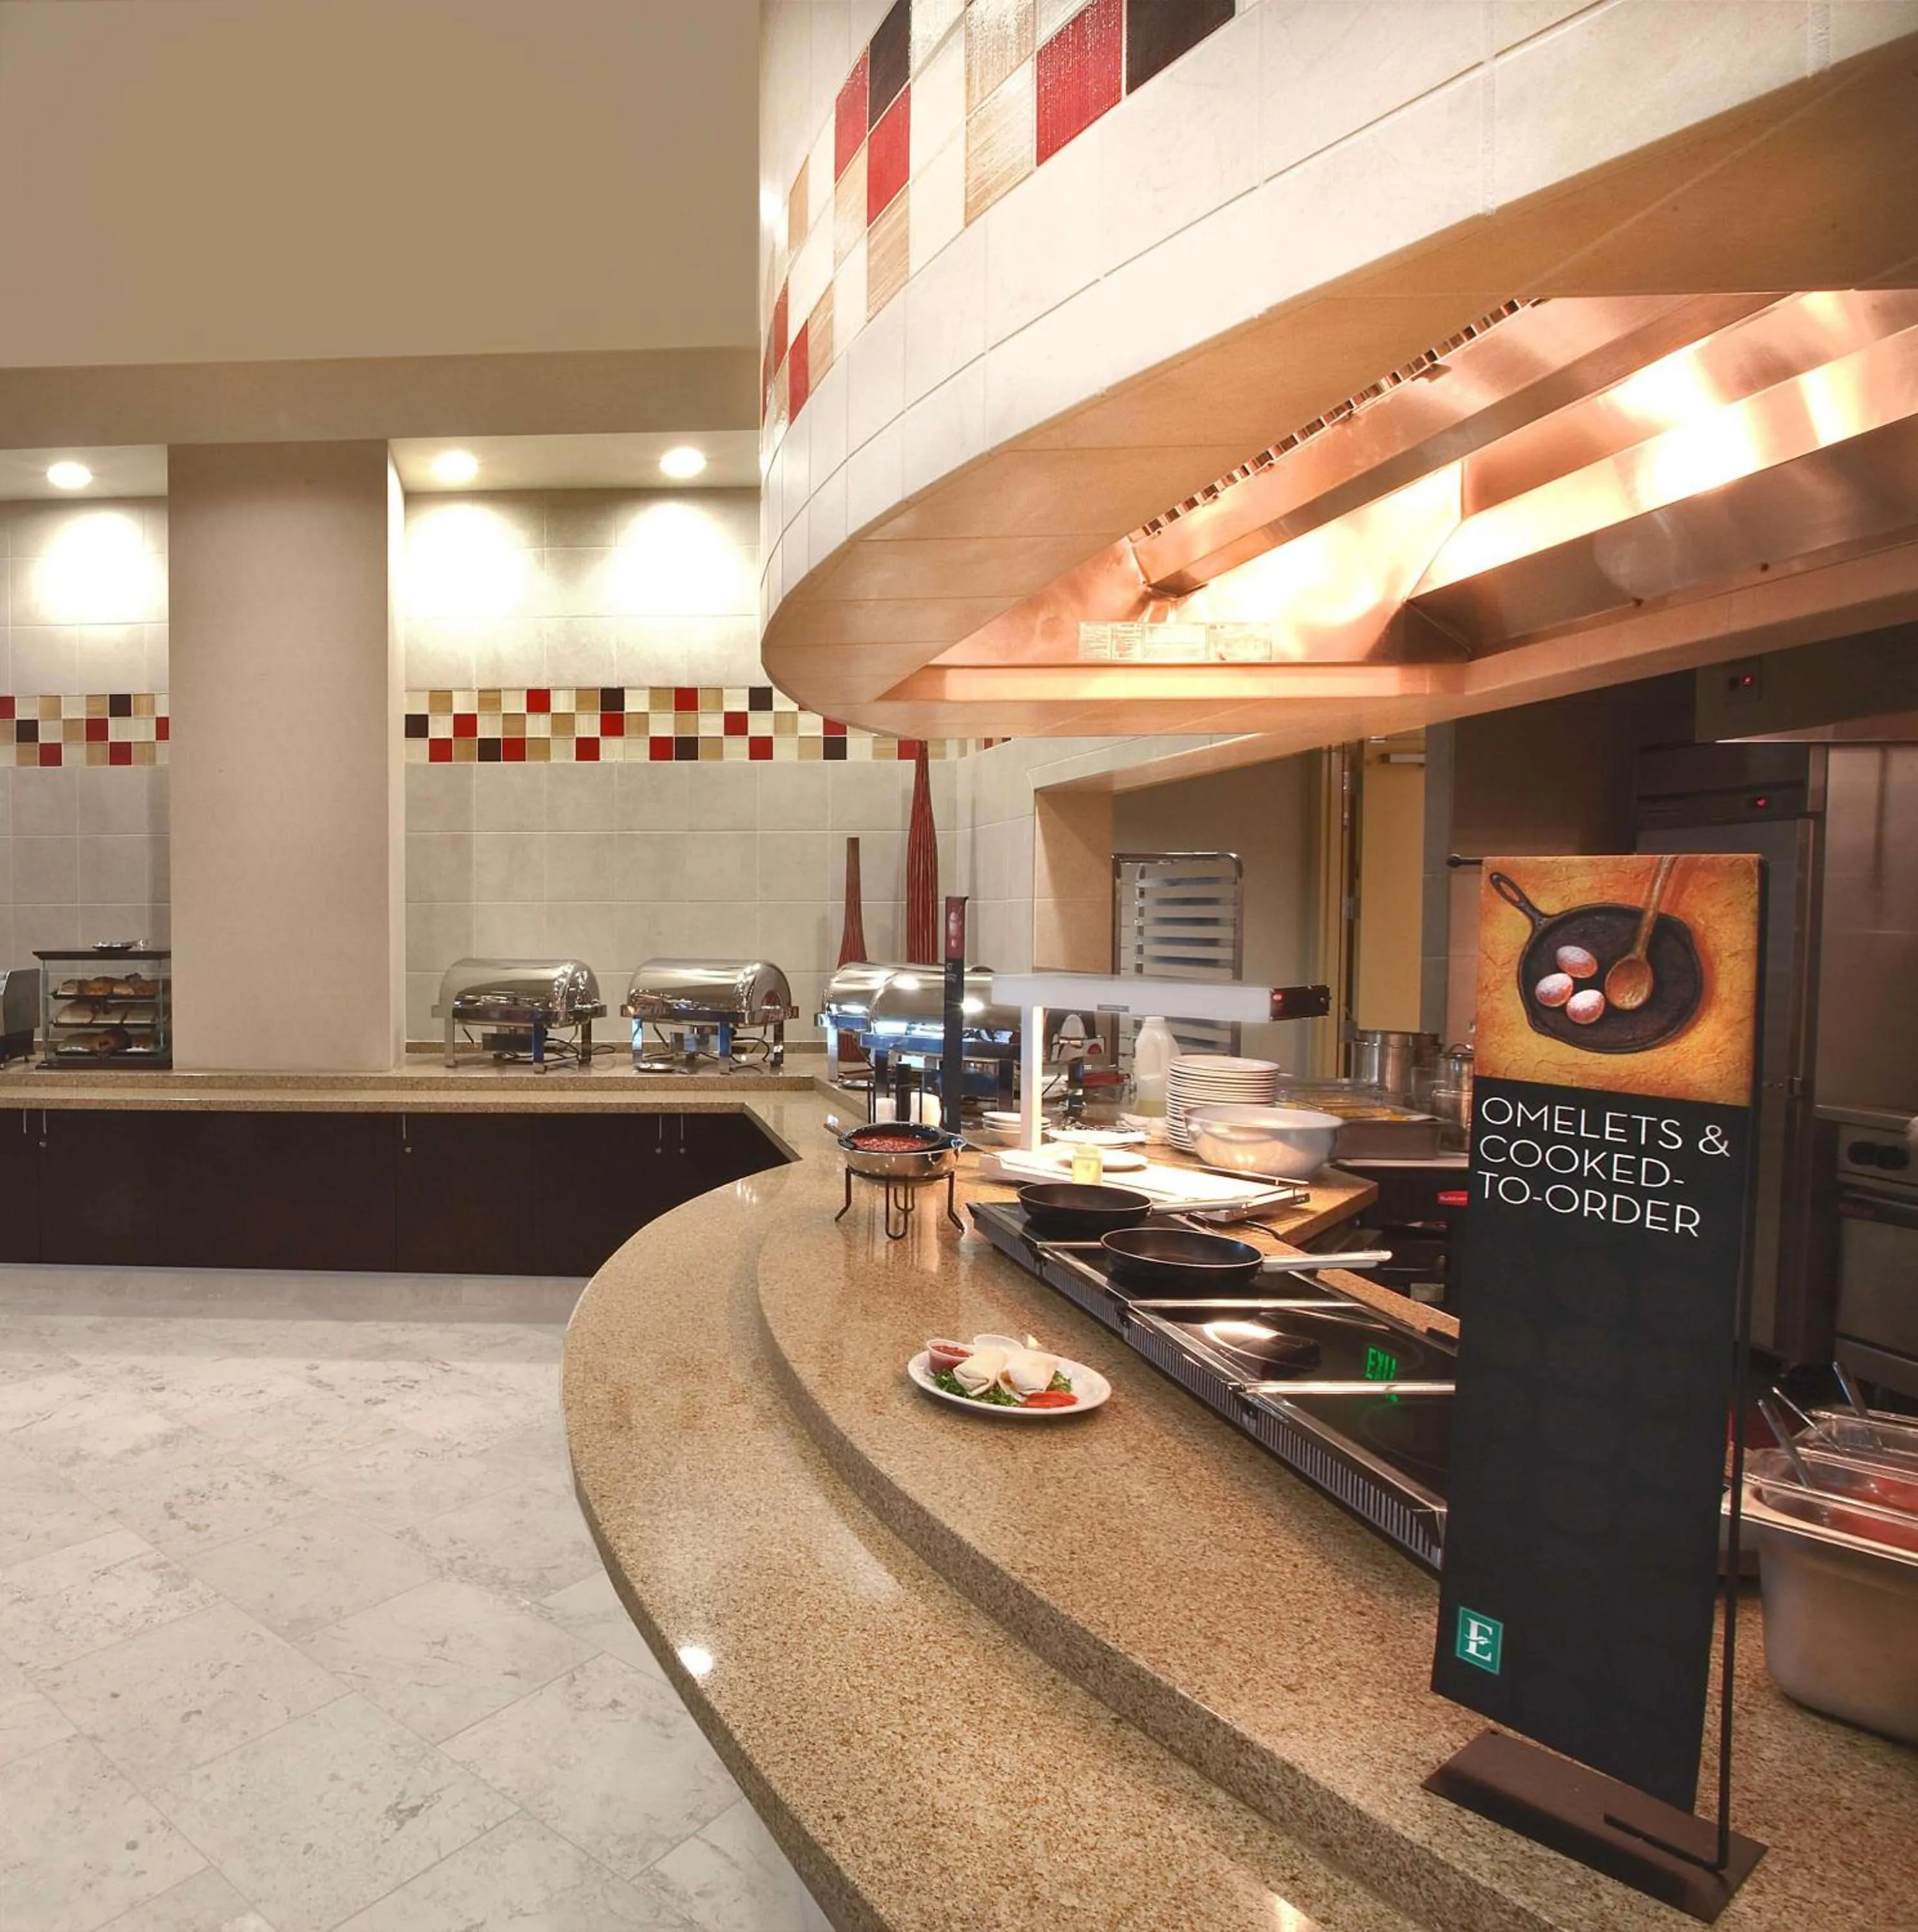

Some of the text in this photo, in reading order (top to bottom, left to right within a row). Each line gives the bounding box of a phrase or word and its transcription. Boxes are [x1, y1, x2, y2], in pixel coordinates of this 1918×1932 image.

[1481, 1097, 1731, 1157] OMELETS &
[1479, 1135, 1685, 1188] COOKED-
[1477, 1170, 1701, 1237] TO-ORDER
